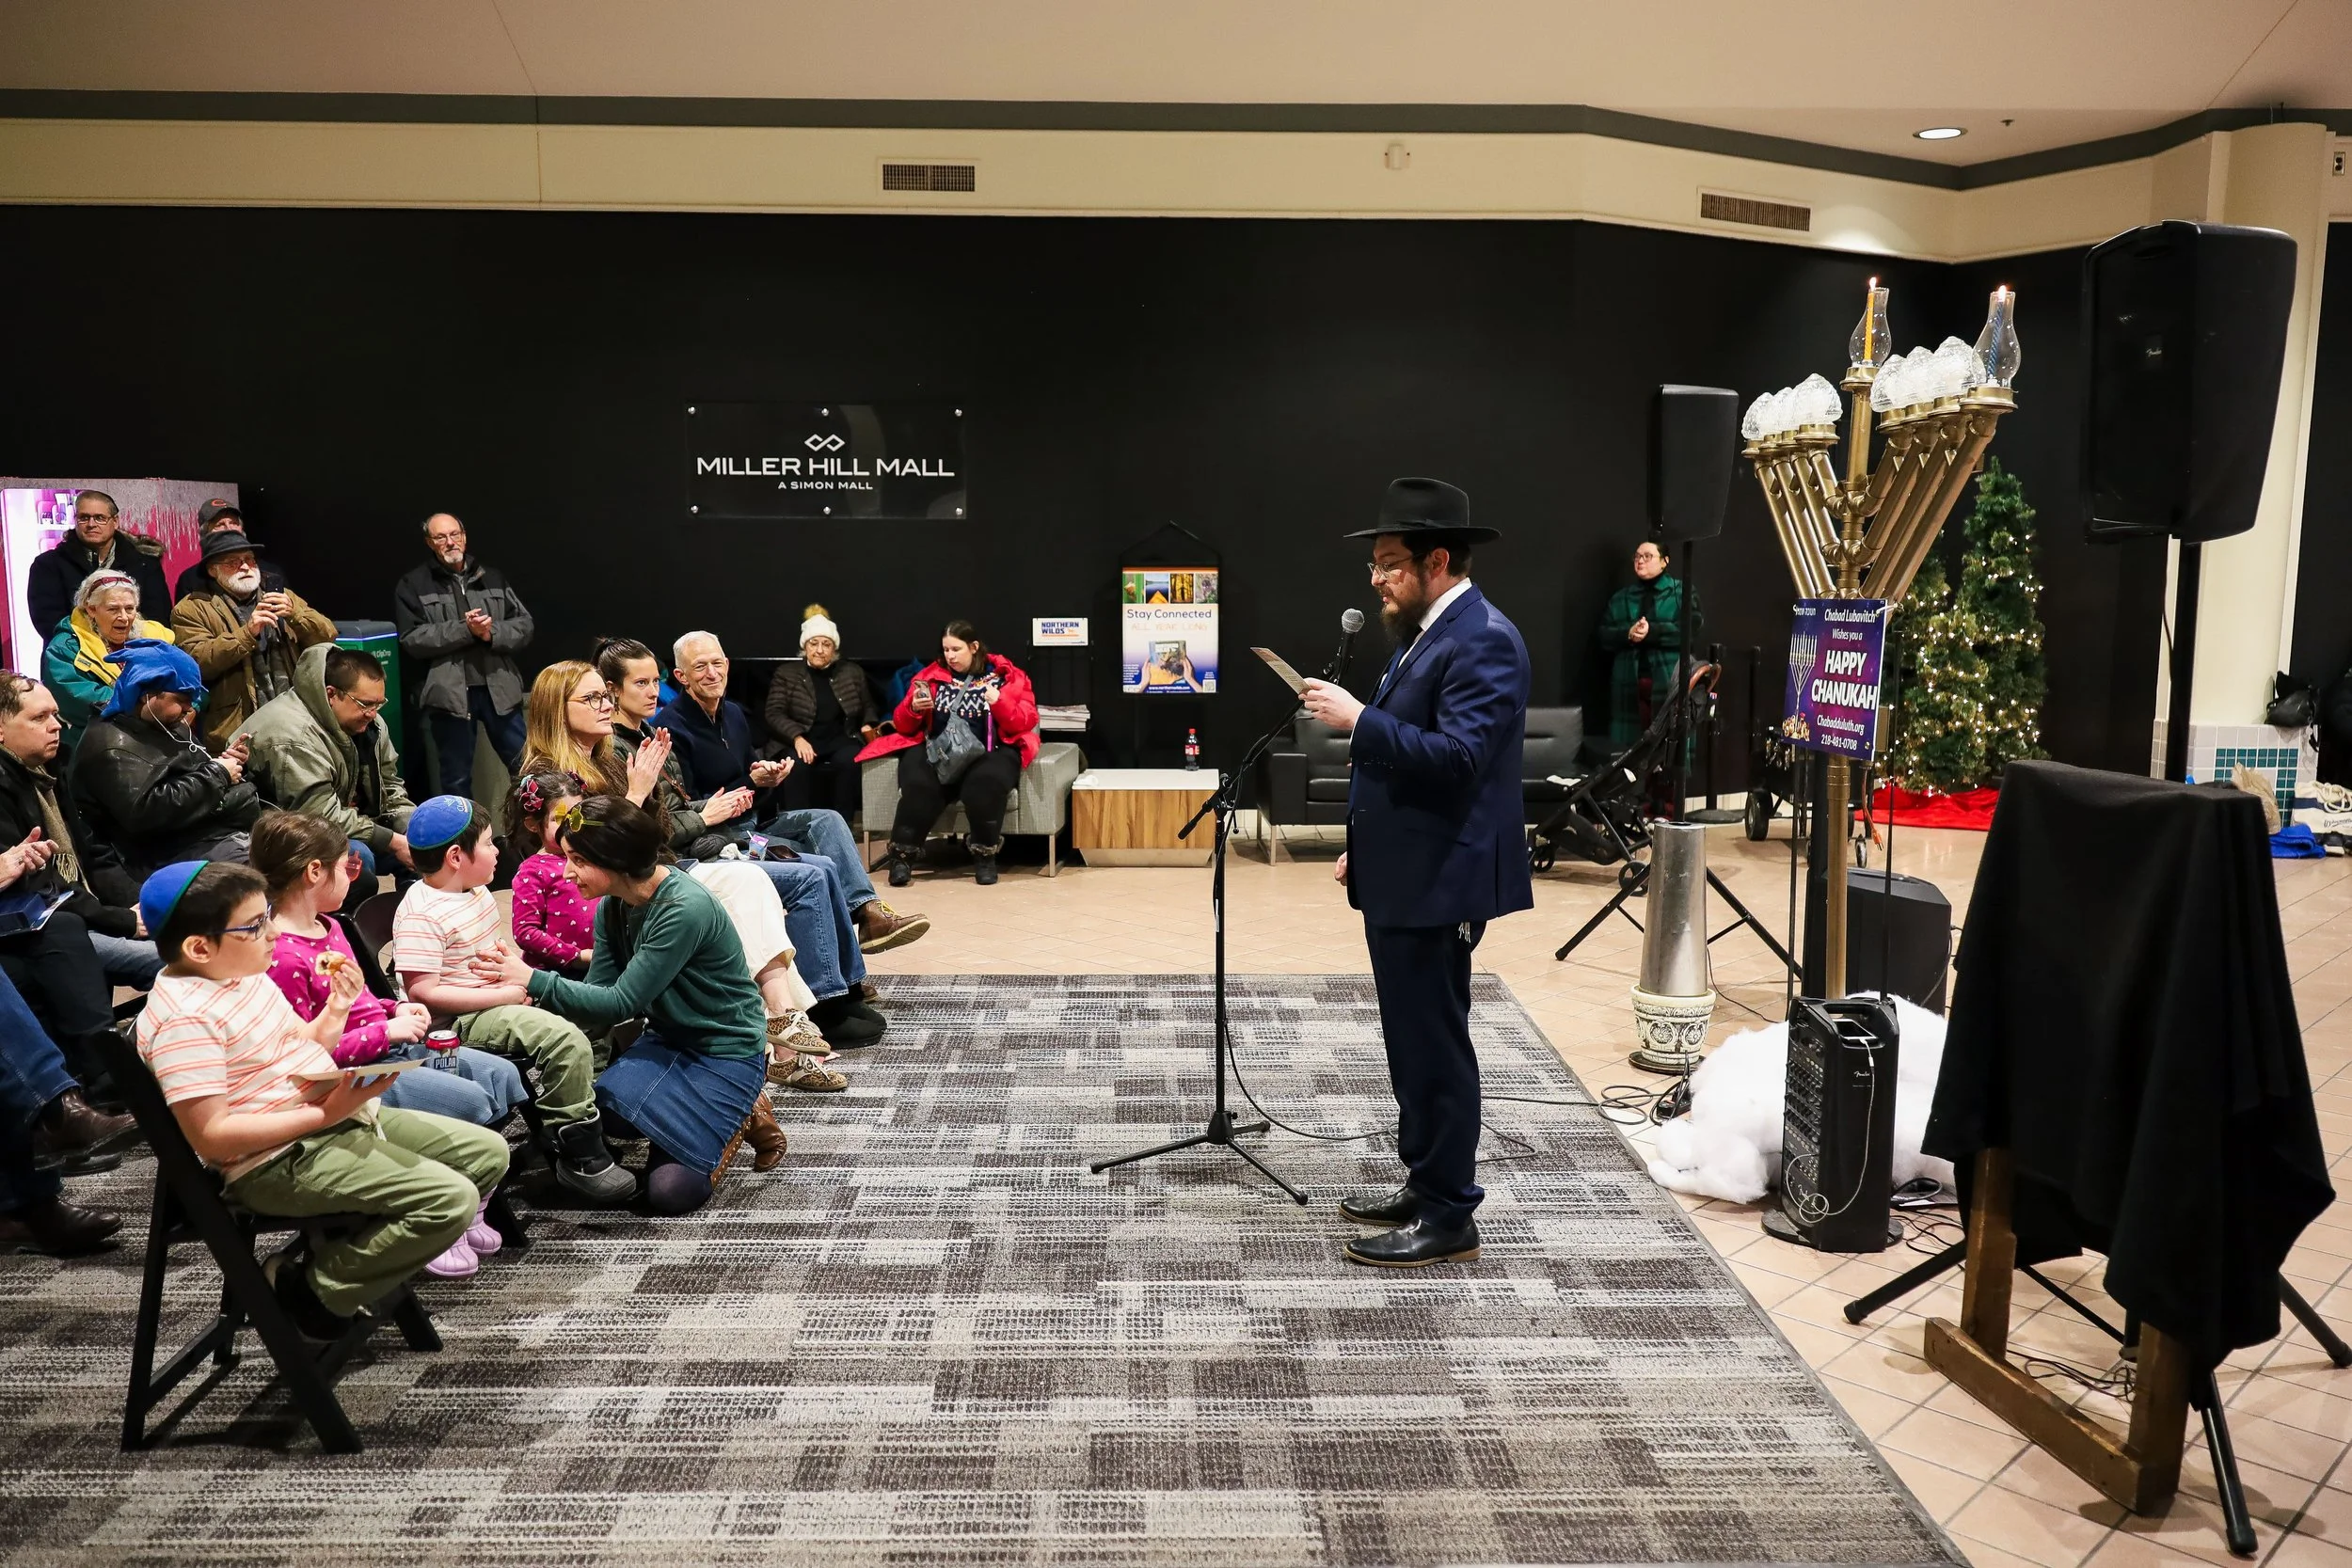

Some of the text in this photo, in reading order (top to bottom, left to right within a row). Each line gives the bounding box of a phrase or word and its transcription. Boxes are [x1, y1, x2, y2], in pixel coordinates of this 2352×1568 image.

[697, 457, 956, 477] MILLER HILL MALL
[777, 482, 873, 490] A SIMON MALL
[1127, 609, 1212, 620] Stay Connected
[1824, 609, 1876, 623] Chabad Lubavitch
[1832, 628, 1850, 640] Wishes
[1849, 631, 1860, 641] you
[1824, 649, 1867, 676] HAPPY
[1811, 678, 1878, 710] CHANUKAH
[1817, 715, 1865, 736] Chabadduluth.org
[1820, 734, 1858, 750] 218-481-0708
[435, 1057, 456, 1069] POLAR
